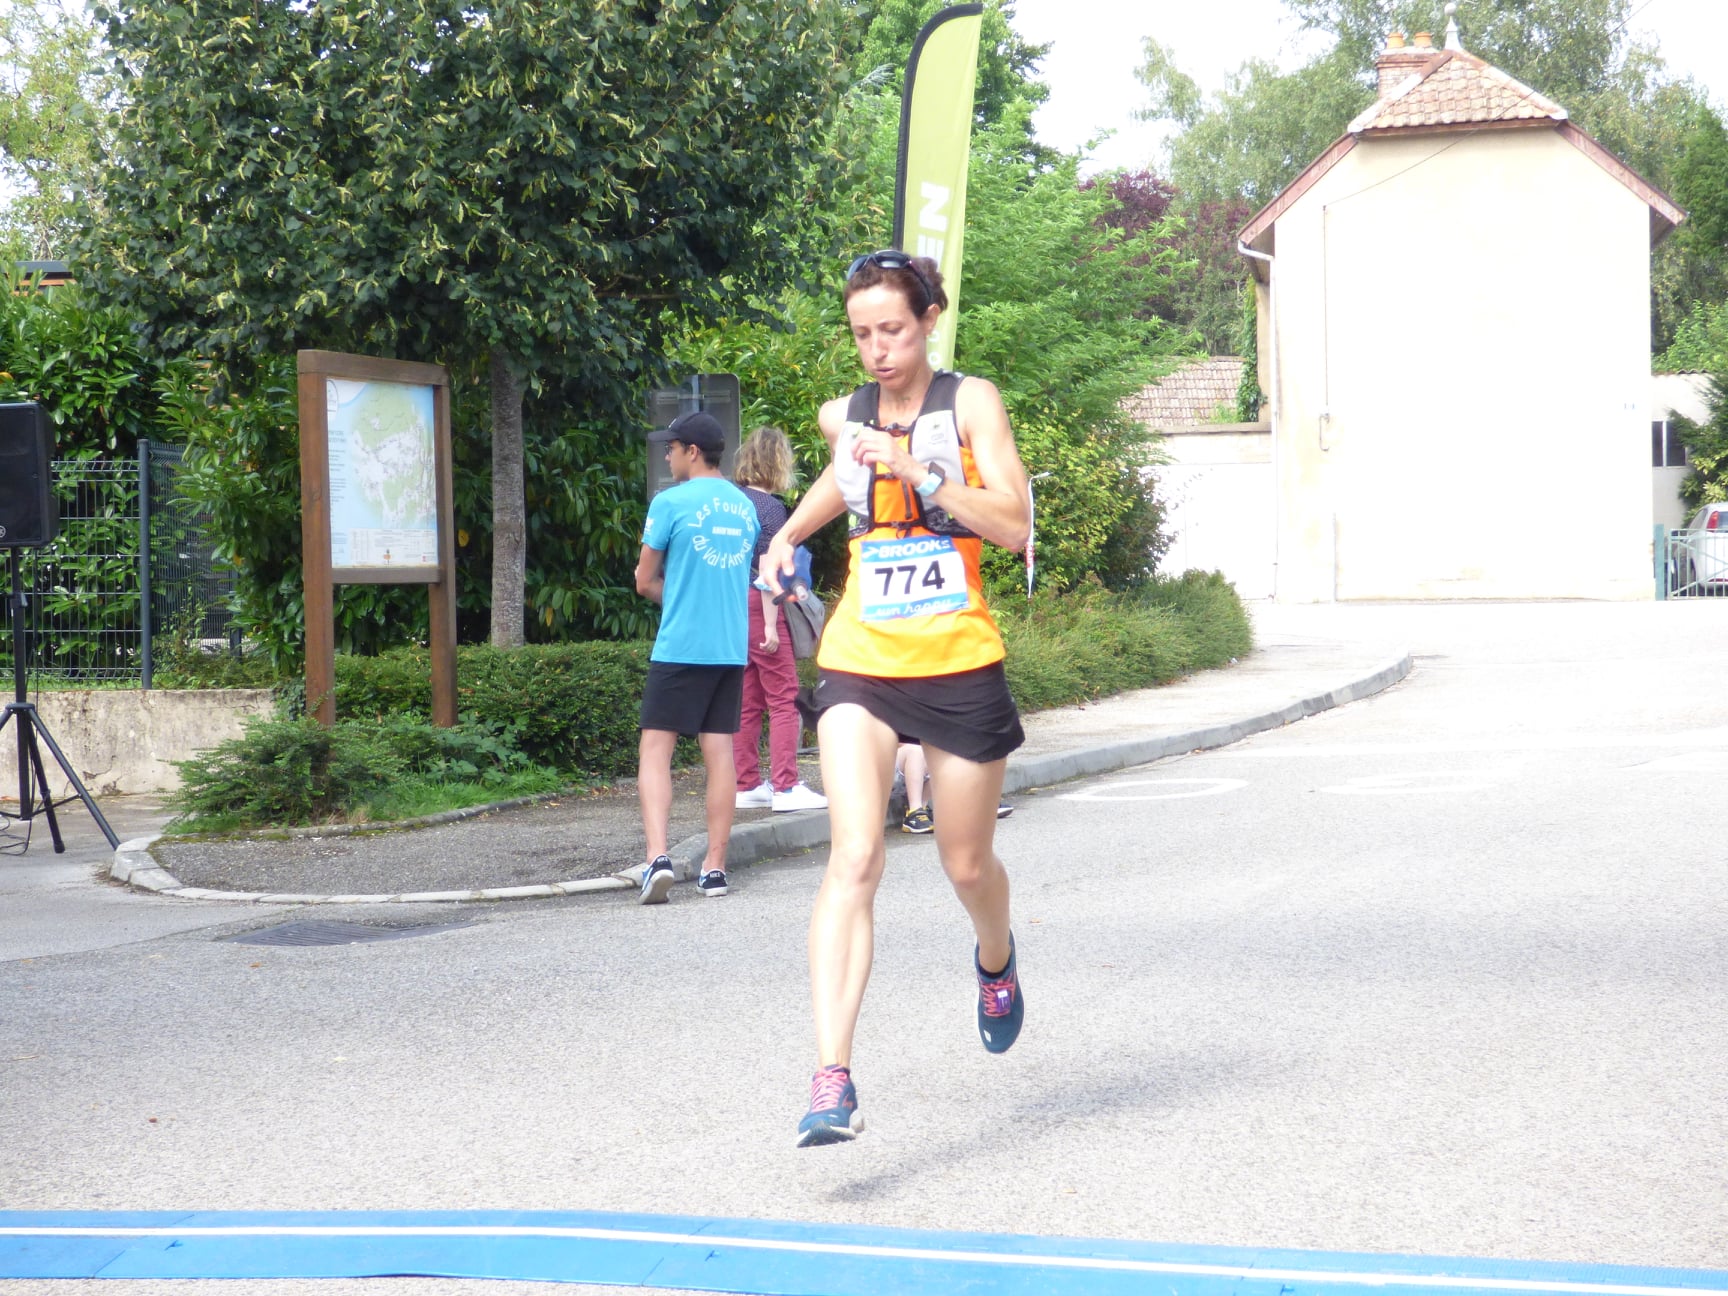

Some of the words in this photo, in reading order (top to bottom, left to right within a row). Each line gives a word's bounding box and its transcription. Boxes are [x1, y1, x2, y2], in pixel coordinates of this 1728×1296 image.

[688, 504, 711, 528] Les
[702, 546, 720, 567] Val
[878, 539, 951, 559] BROOKS
[874, 560, 946, 597] 774
